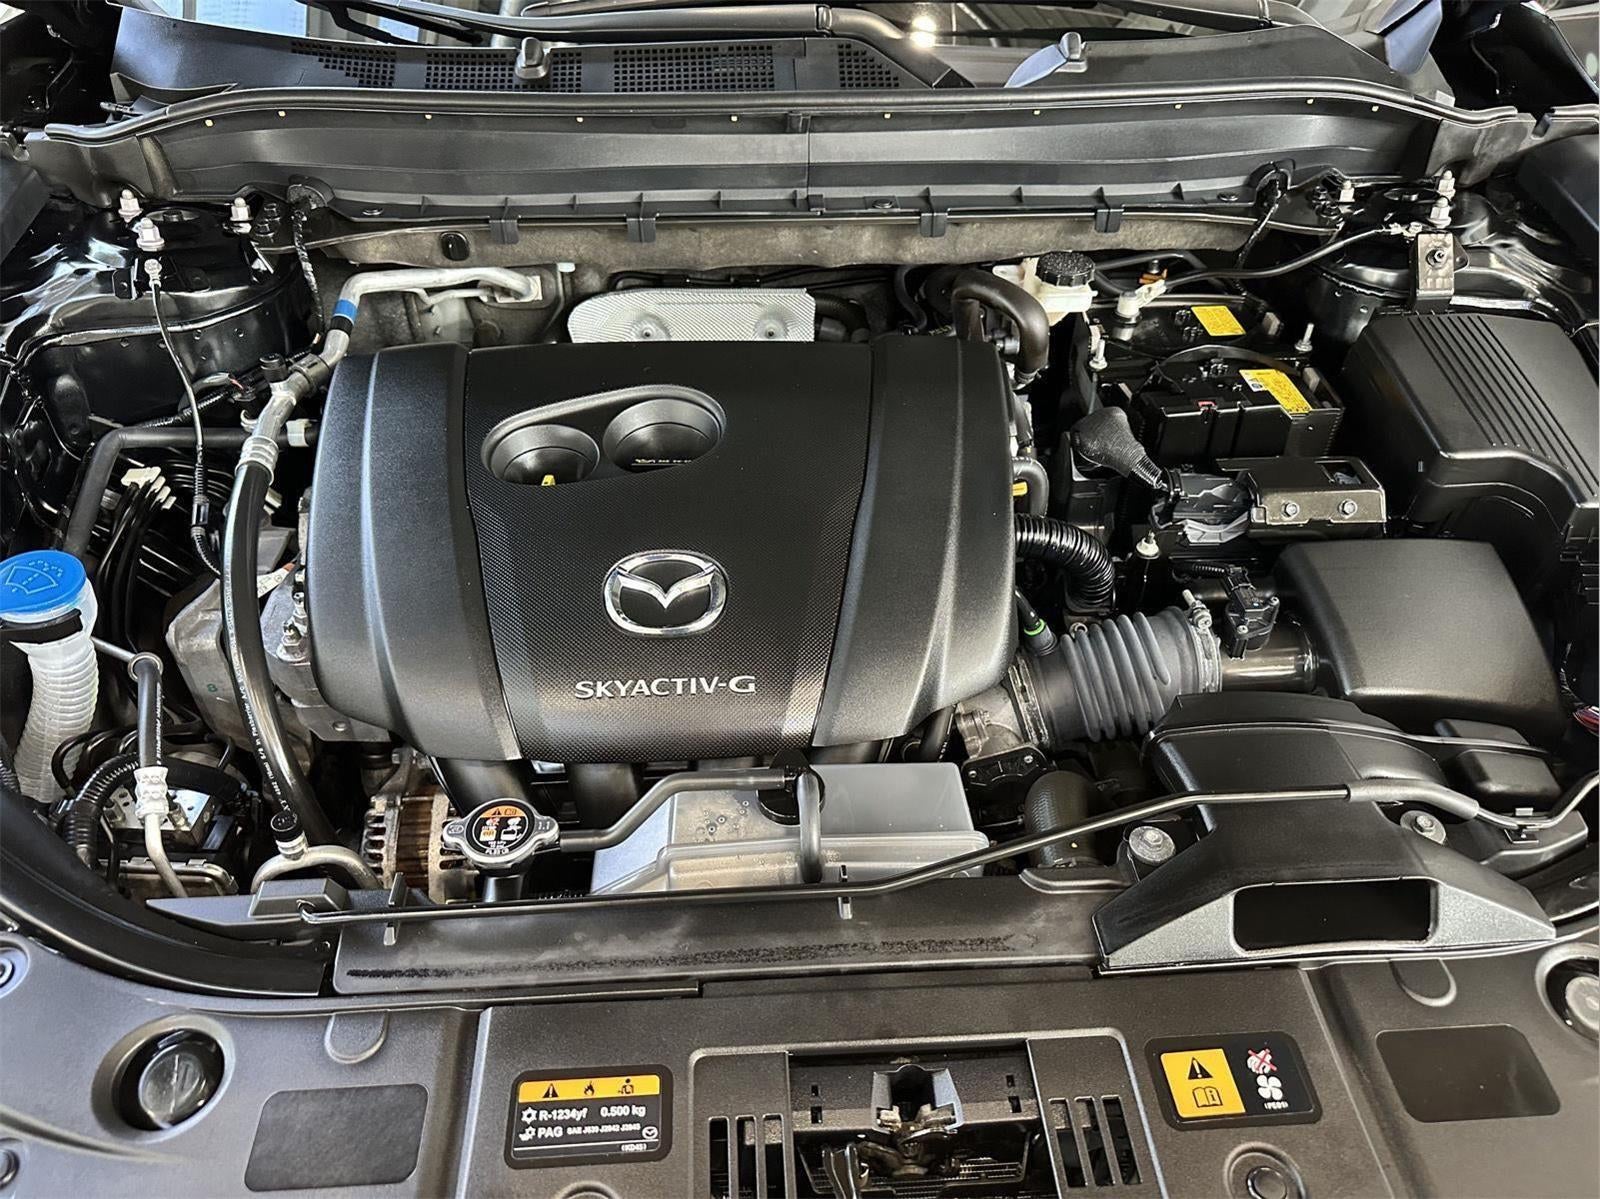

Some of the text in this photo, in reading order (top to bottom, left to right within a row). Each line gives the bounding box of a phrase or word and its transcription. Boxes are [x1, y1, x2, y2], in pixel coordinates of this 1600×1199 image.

[574, 675, 757, 700] SKYACTIV-G
[538, 821, 551, 830] 1.1
[538, 1104, 646, 1121] R-1234yf 0.500 kg
[537, 1125, 564, 1139] PAG
